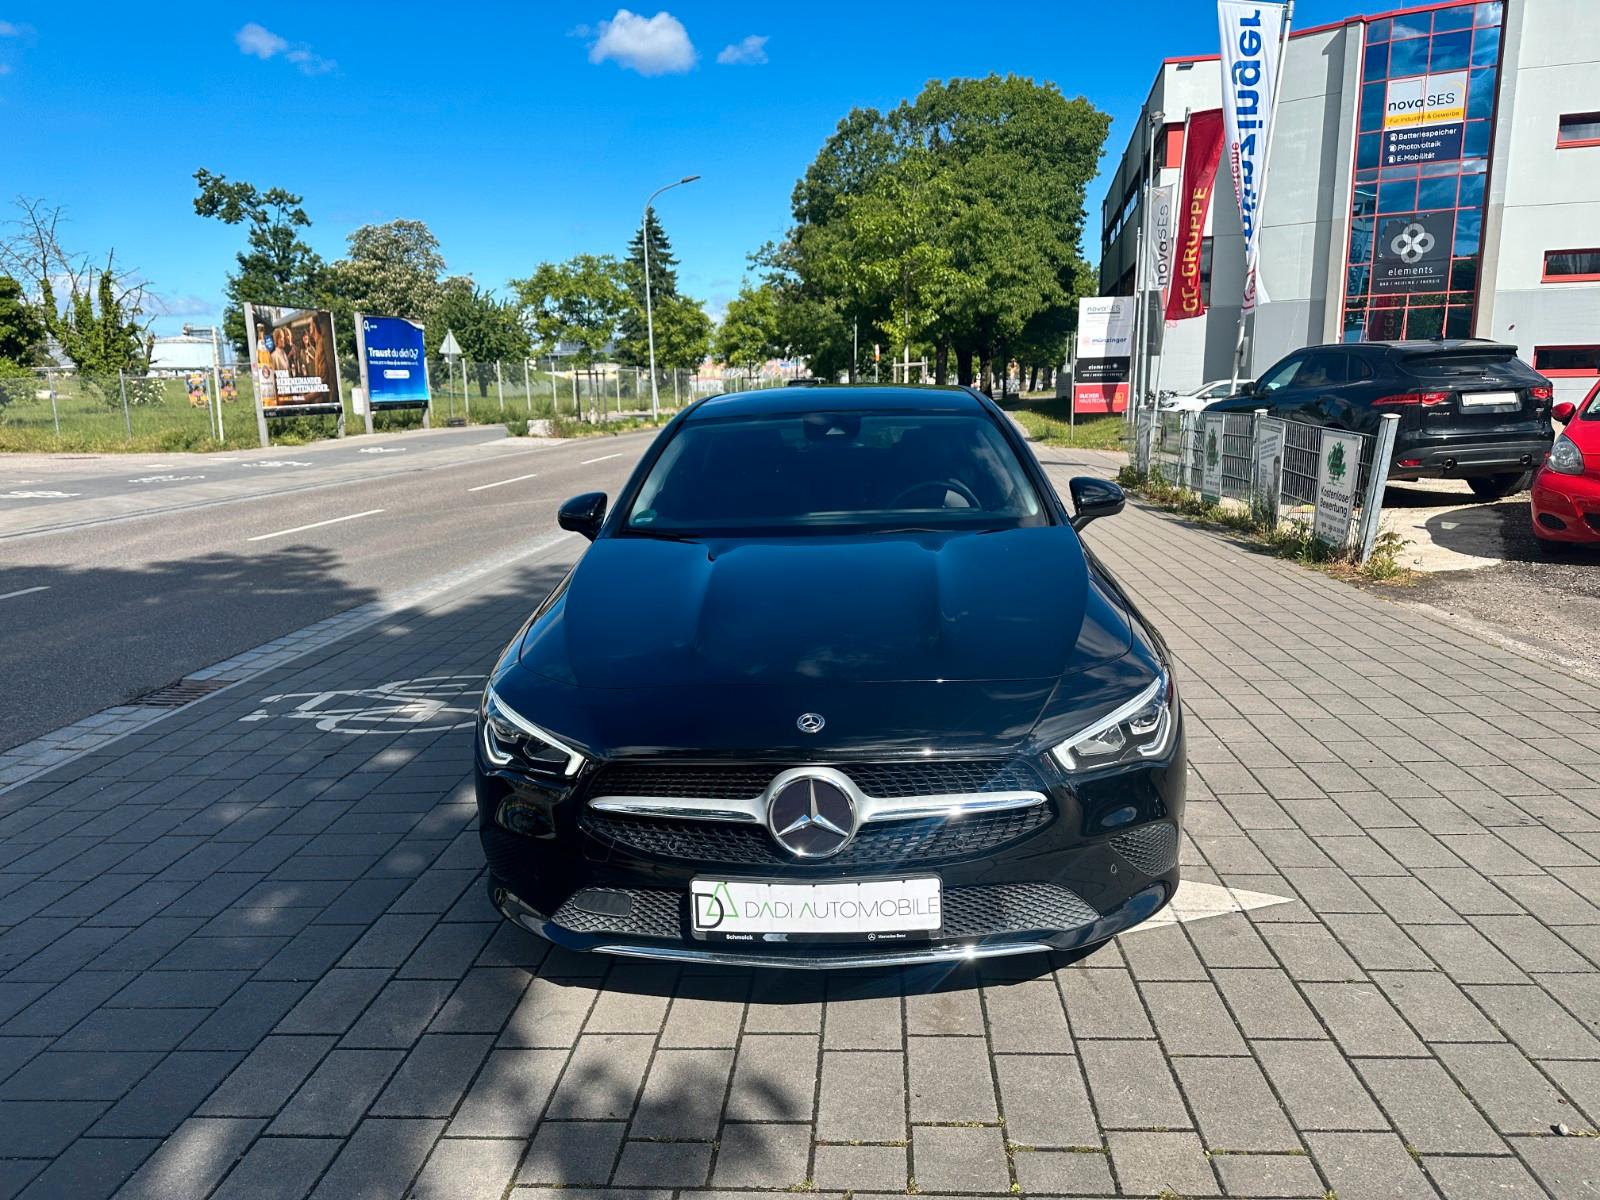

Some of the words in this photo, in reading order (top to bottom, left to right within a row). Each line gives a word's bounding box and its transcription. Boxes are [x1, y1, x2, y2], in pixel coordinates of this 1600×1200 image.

[1432, 111, 1460, 119] Gewerbe
[1398, 128, 1457, 140] Batteriespeicher
[1397, 140, 1442, 151] Photovoltaik
[1397, 152, 1435, 162] E-Mobilität
[1158, 204, 1170, 286] novaSES
[1388, 266, 1433, 276] elements
[368, 347, 391, 358] Traust
[391, 348, 399, 358] du
[1320, 497, 1348, 518] Bewertung
[745, 901, 793, 919] DADI
[798, 896, 940, 919] AUTOMOBILE
